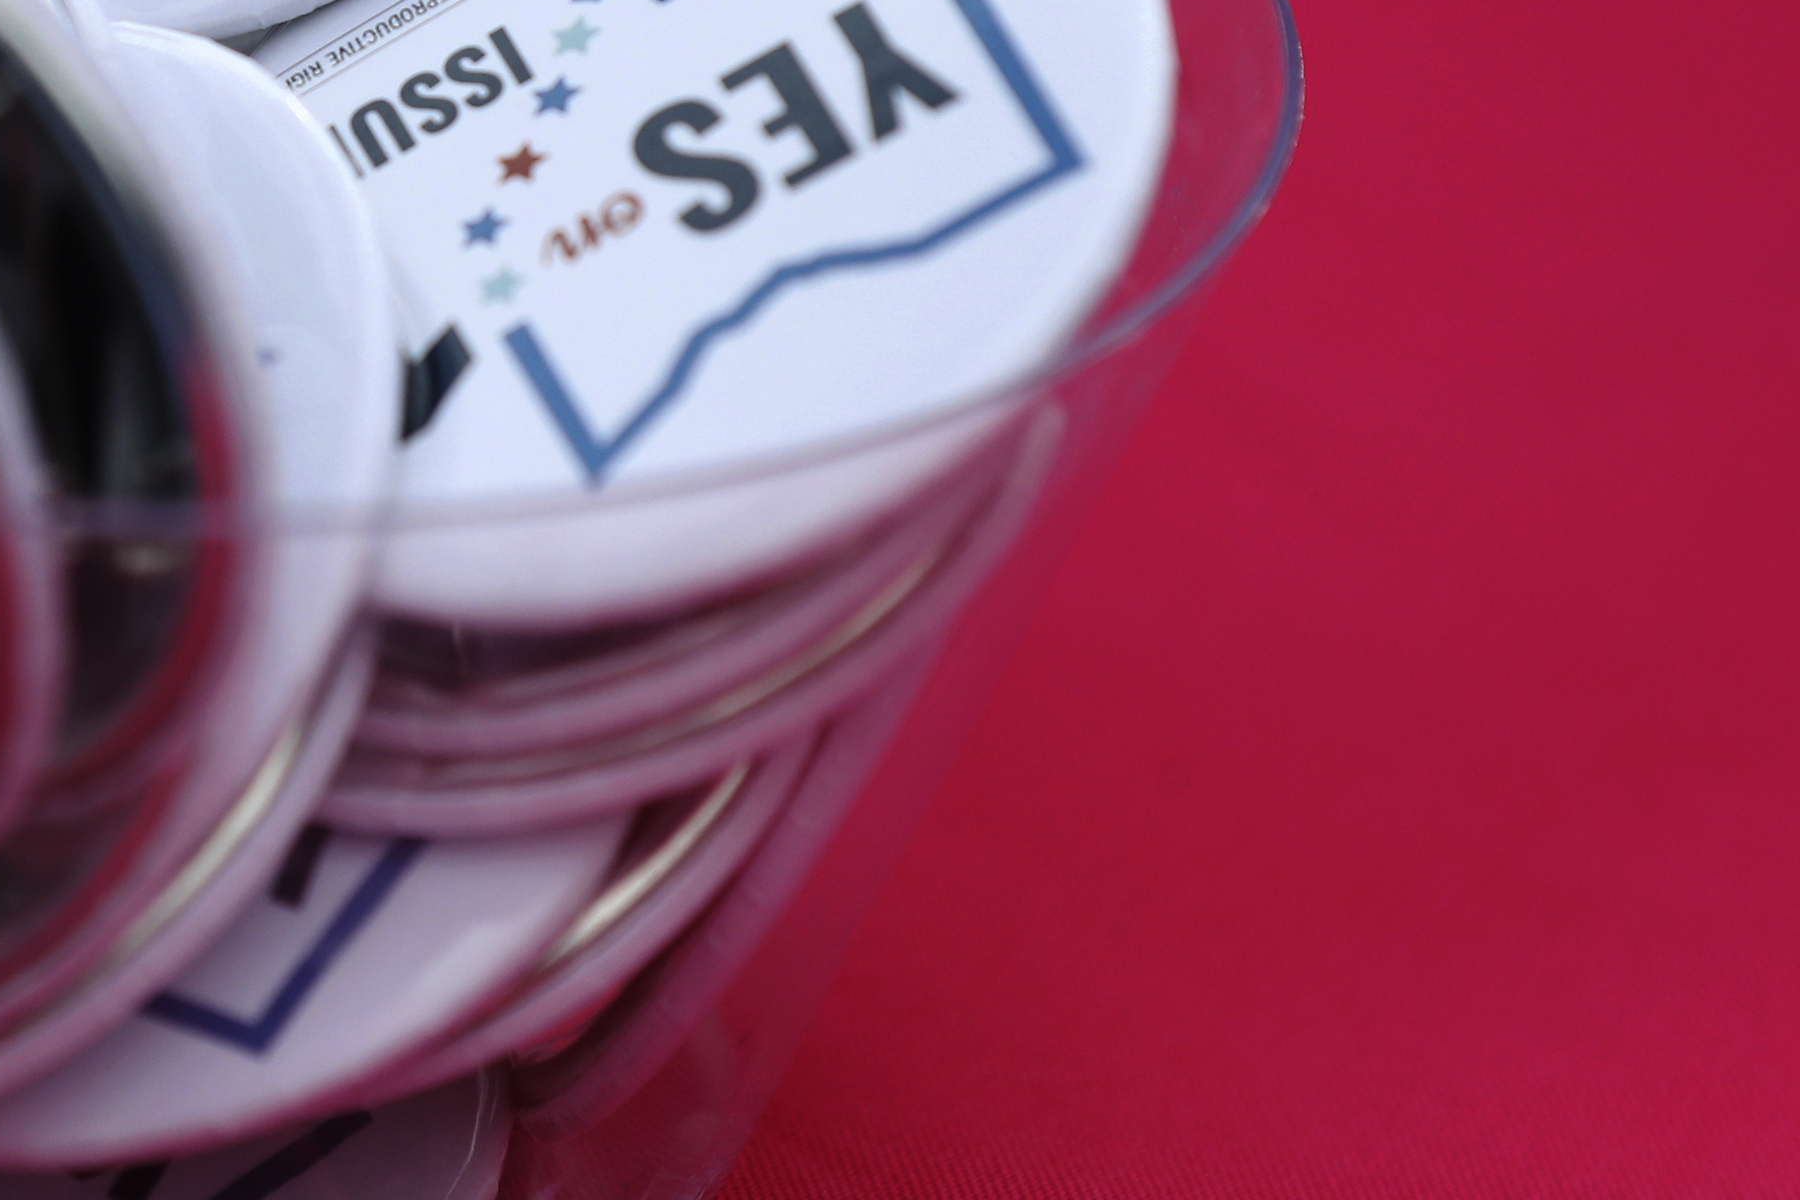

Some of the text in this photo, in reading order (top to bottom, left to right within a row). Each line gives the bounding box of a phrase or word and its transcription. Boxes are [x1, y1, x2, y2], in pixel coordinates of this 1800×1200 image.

[285, 60, 325, 91] RIG
[328, 26, 534, 178] ISSU
[543, 0, 964, 267] YES on
